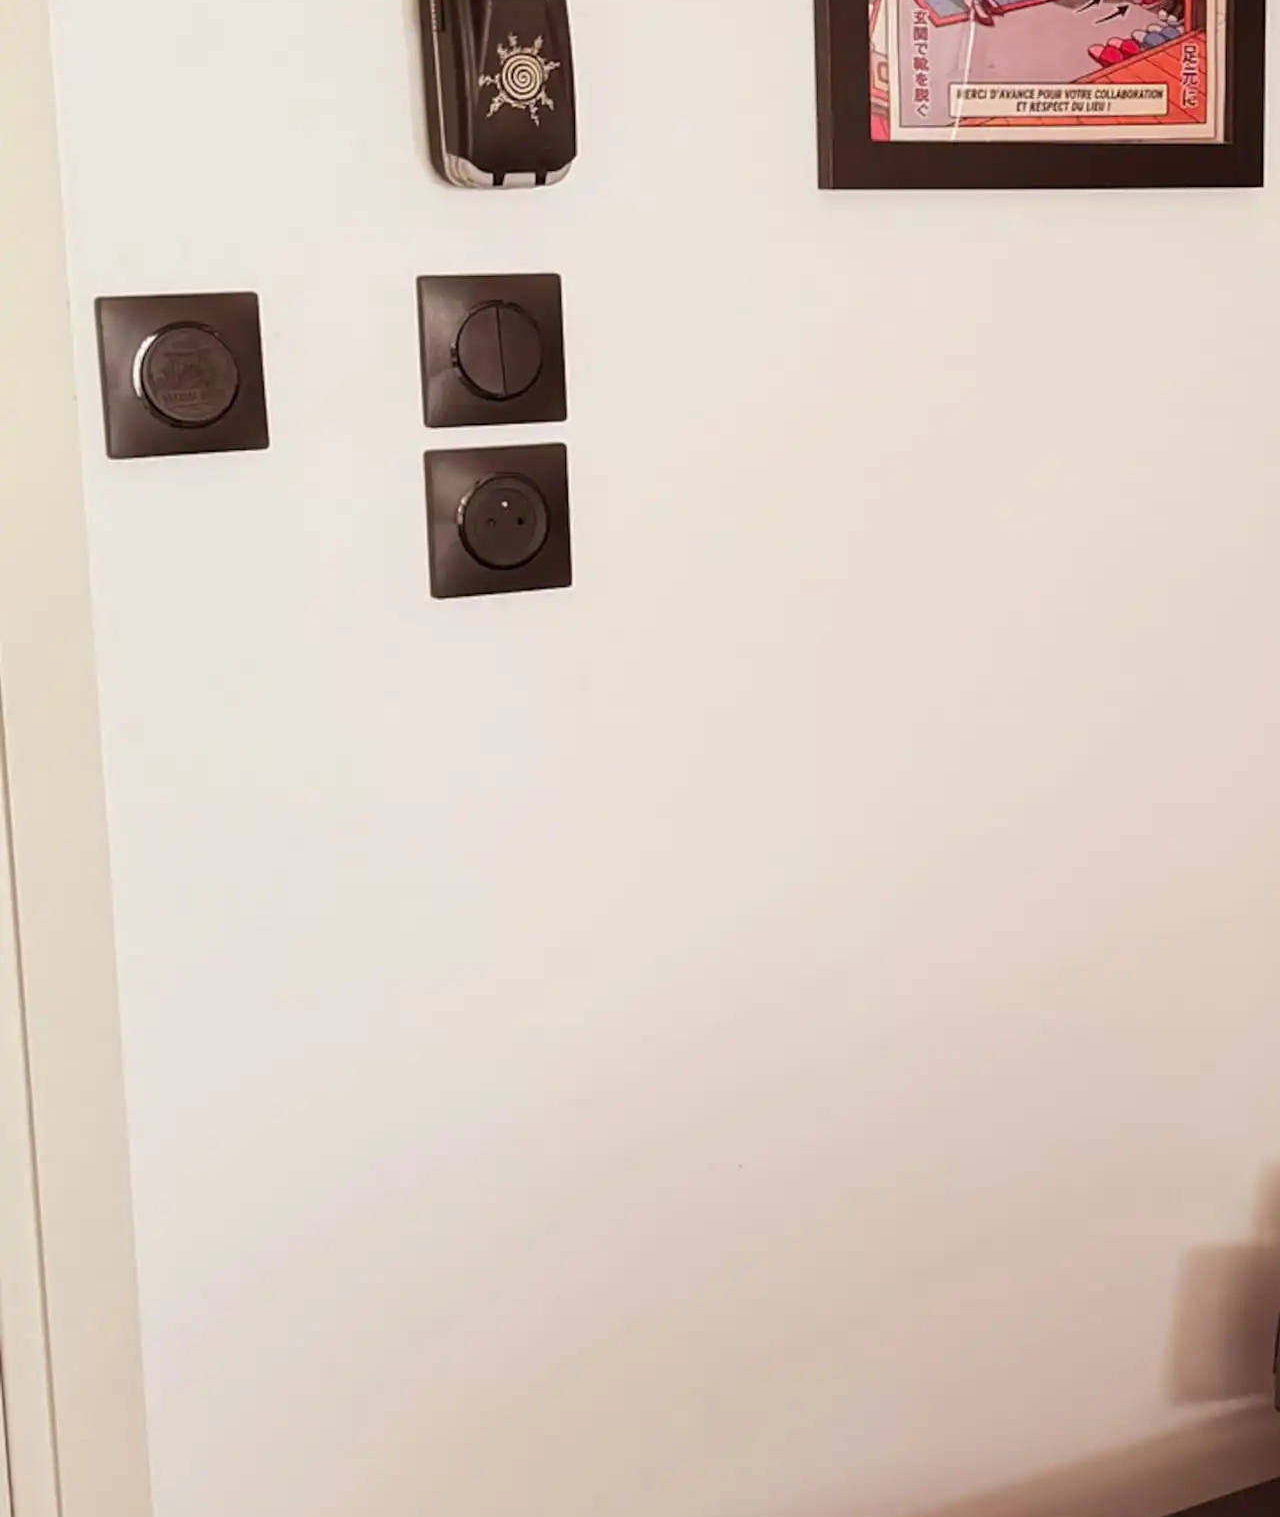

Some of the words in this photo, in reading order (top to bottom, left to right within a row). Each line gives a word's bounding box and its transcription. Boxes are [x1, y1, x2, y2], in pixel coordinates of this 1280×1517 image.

[990, 88, 1035, 101] D'AVANCE
[1037, 88, 1063, 100] POUR
[1065, 88, 1092, 100] VOTRE
[1095, 89, 1163, 101] COLLABORATION
[1016, 101, 1027, 113] ET
[1030, 101, 1070, 113] RESPECT
[1072, 101, 1084, 113] DU
[1086, 101, 1105, 113] LIEU
